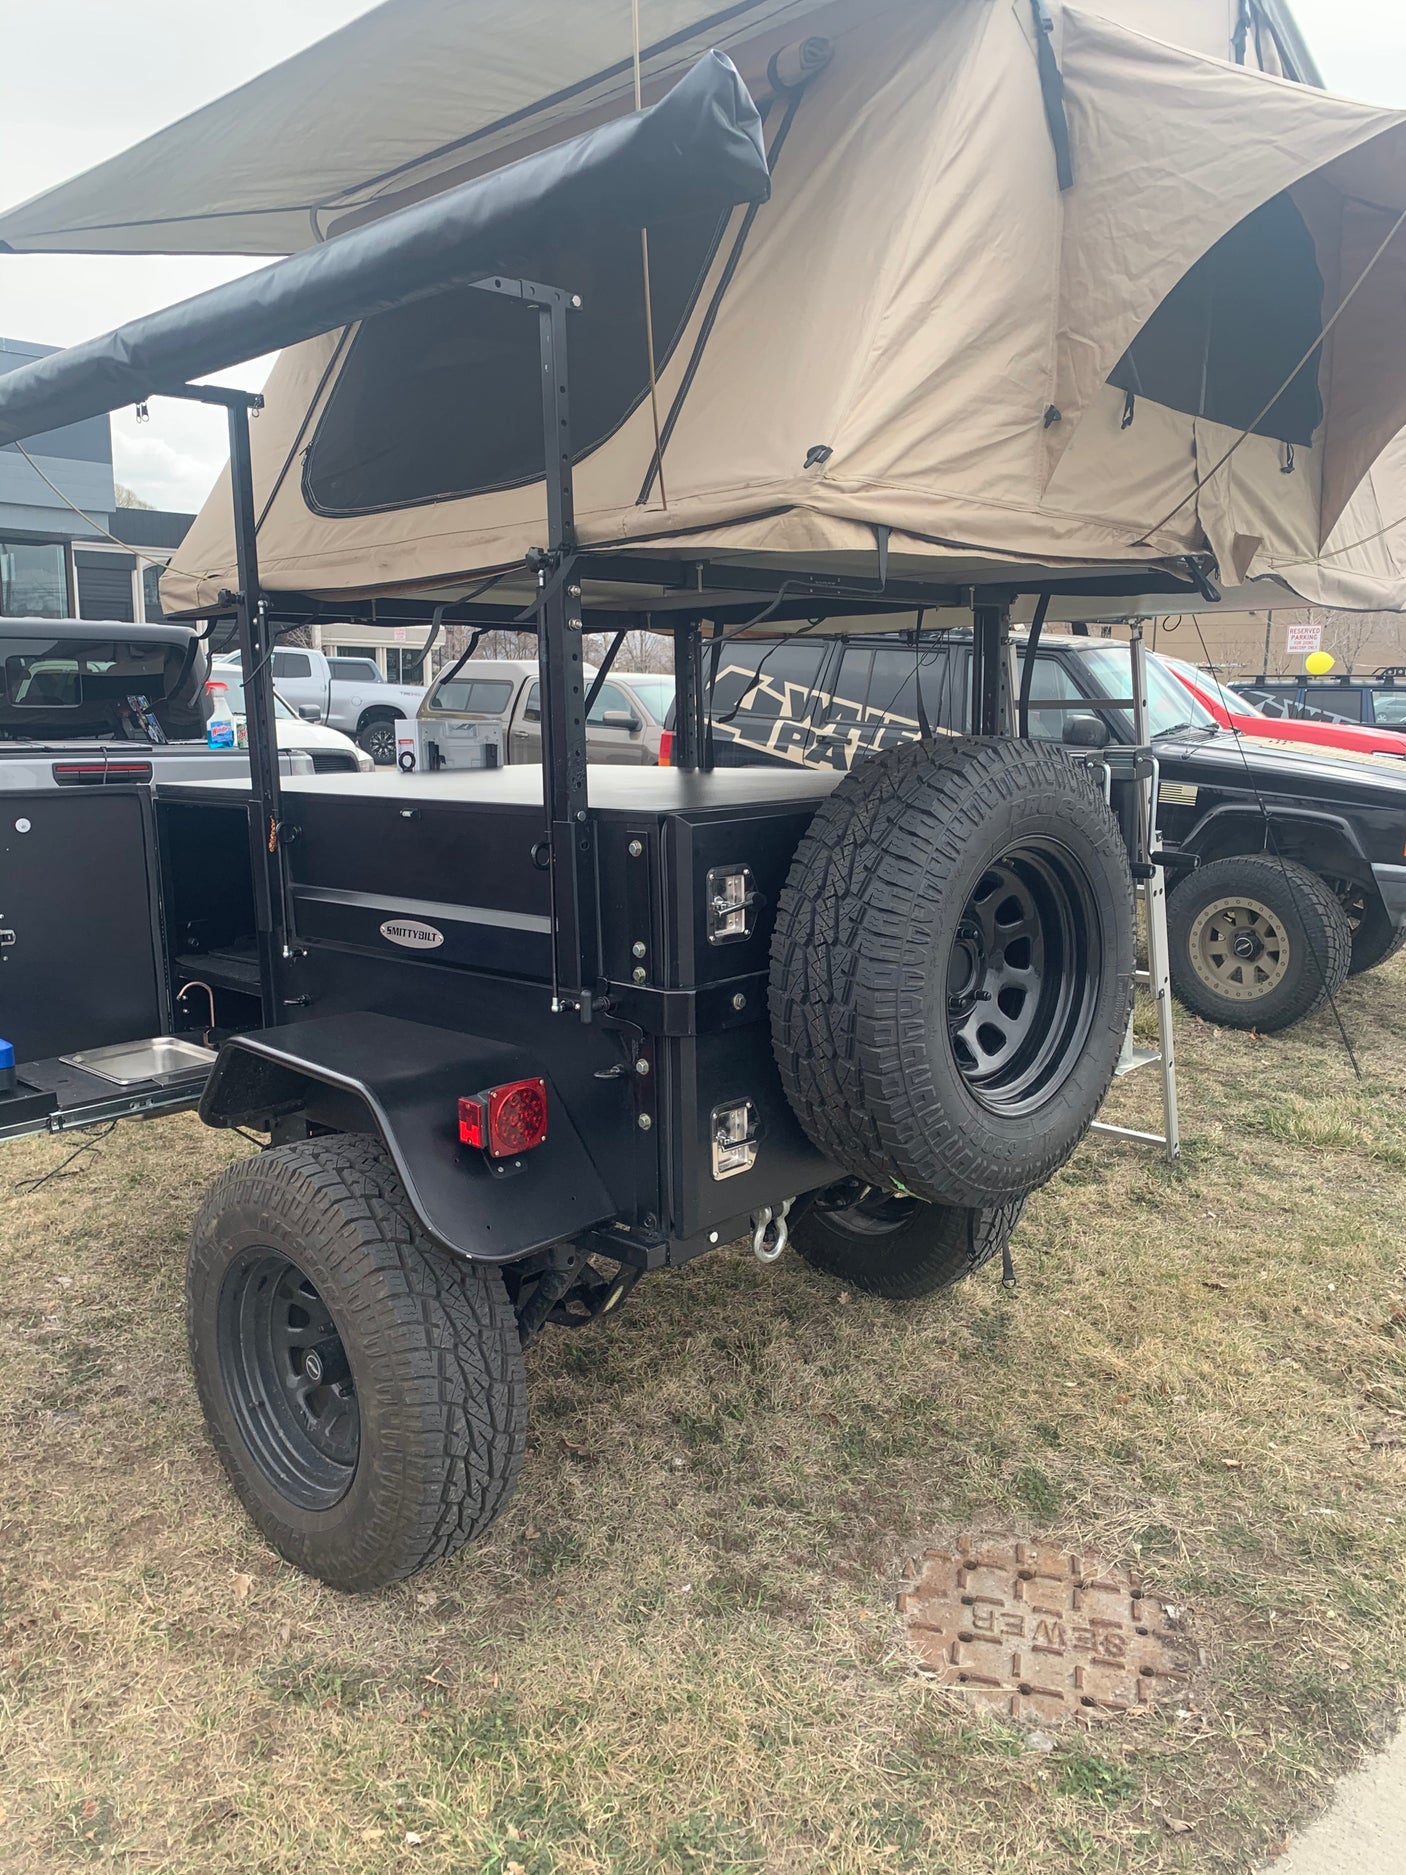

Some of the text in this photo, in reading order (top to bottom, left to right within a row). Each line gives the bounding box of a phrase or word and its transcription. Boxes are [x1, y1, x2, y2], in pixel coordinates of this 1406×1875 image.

[1289, 627, 1320, 635] RESERVED
[386, 925, 438, 942] SMITTYBILT
[971, 1605, 1129, 1658] SEWER
